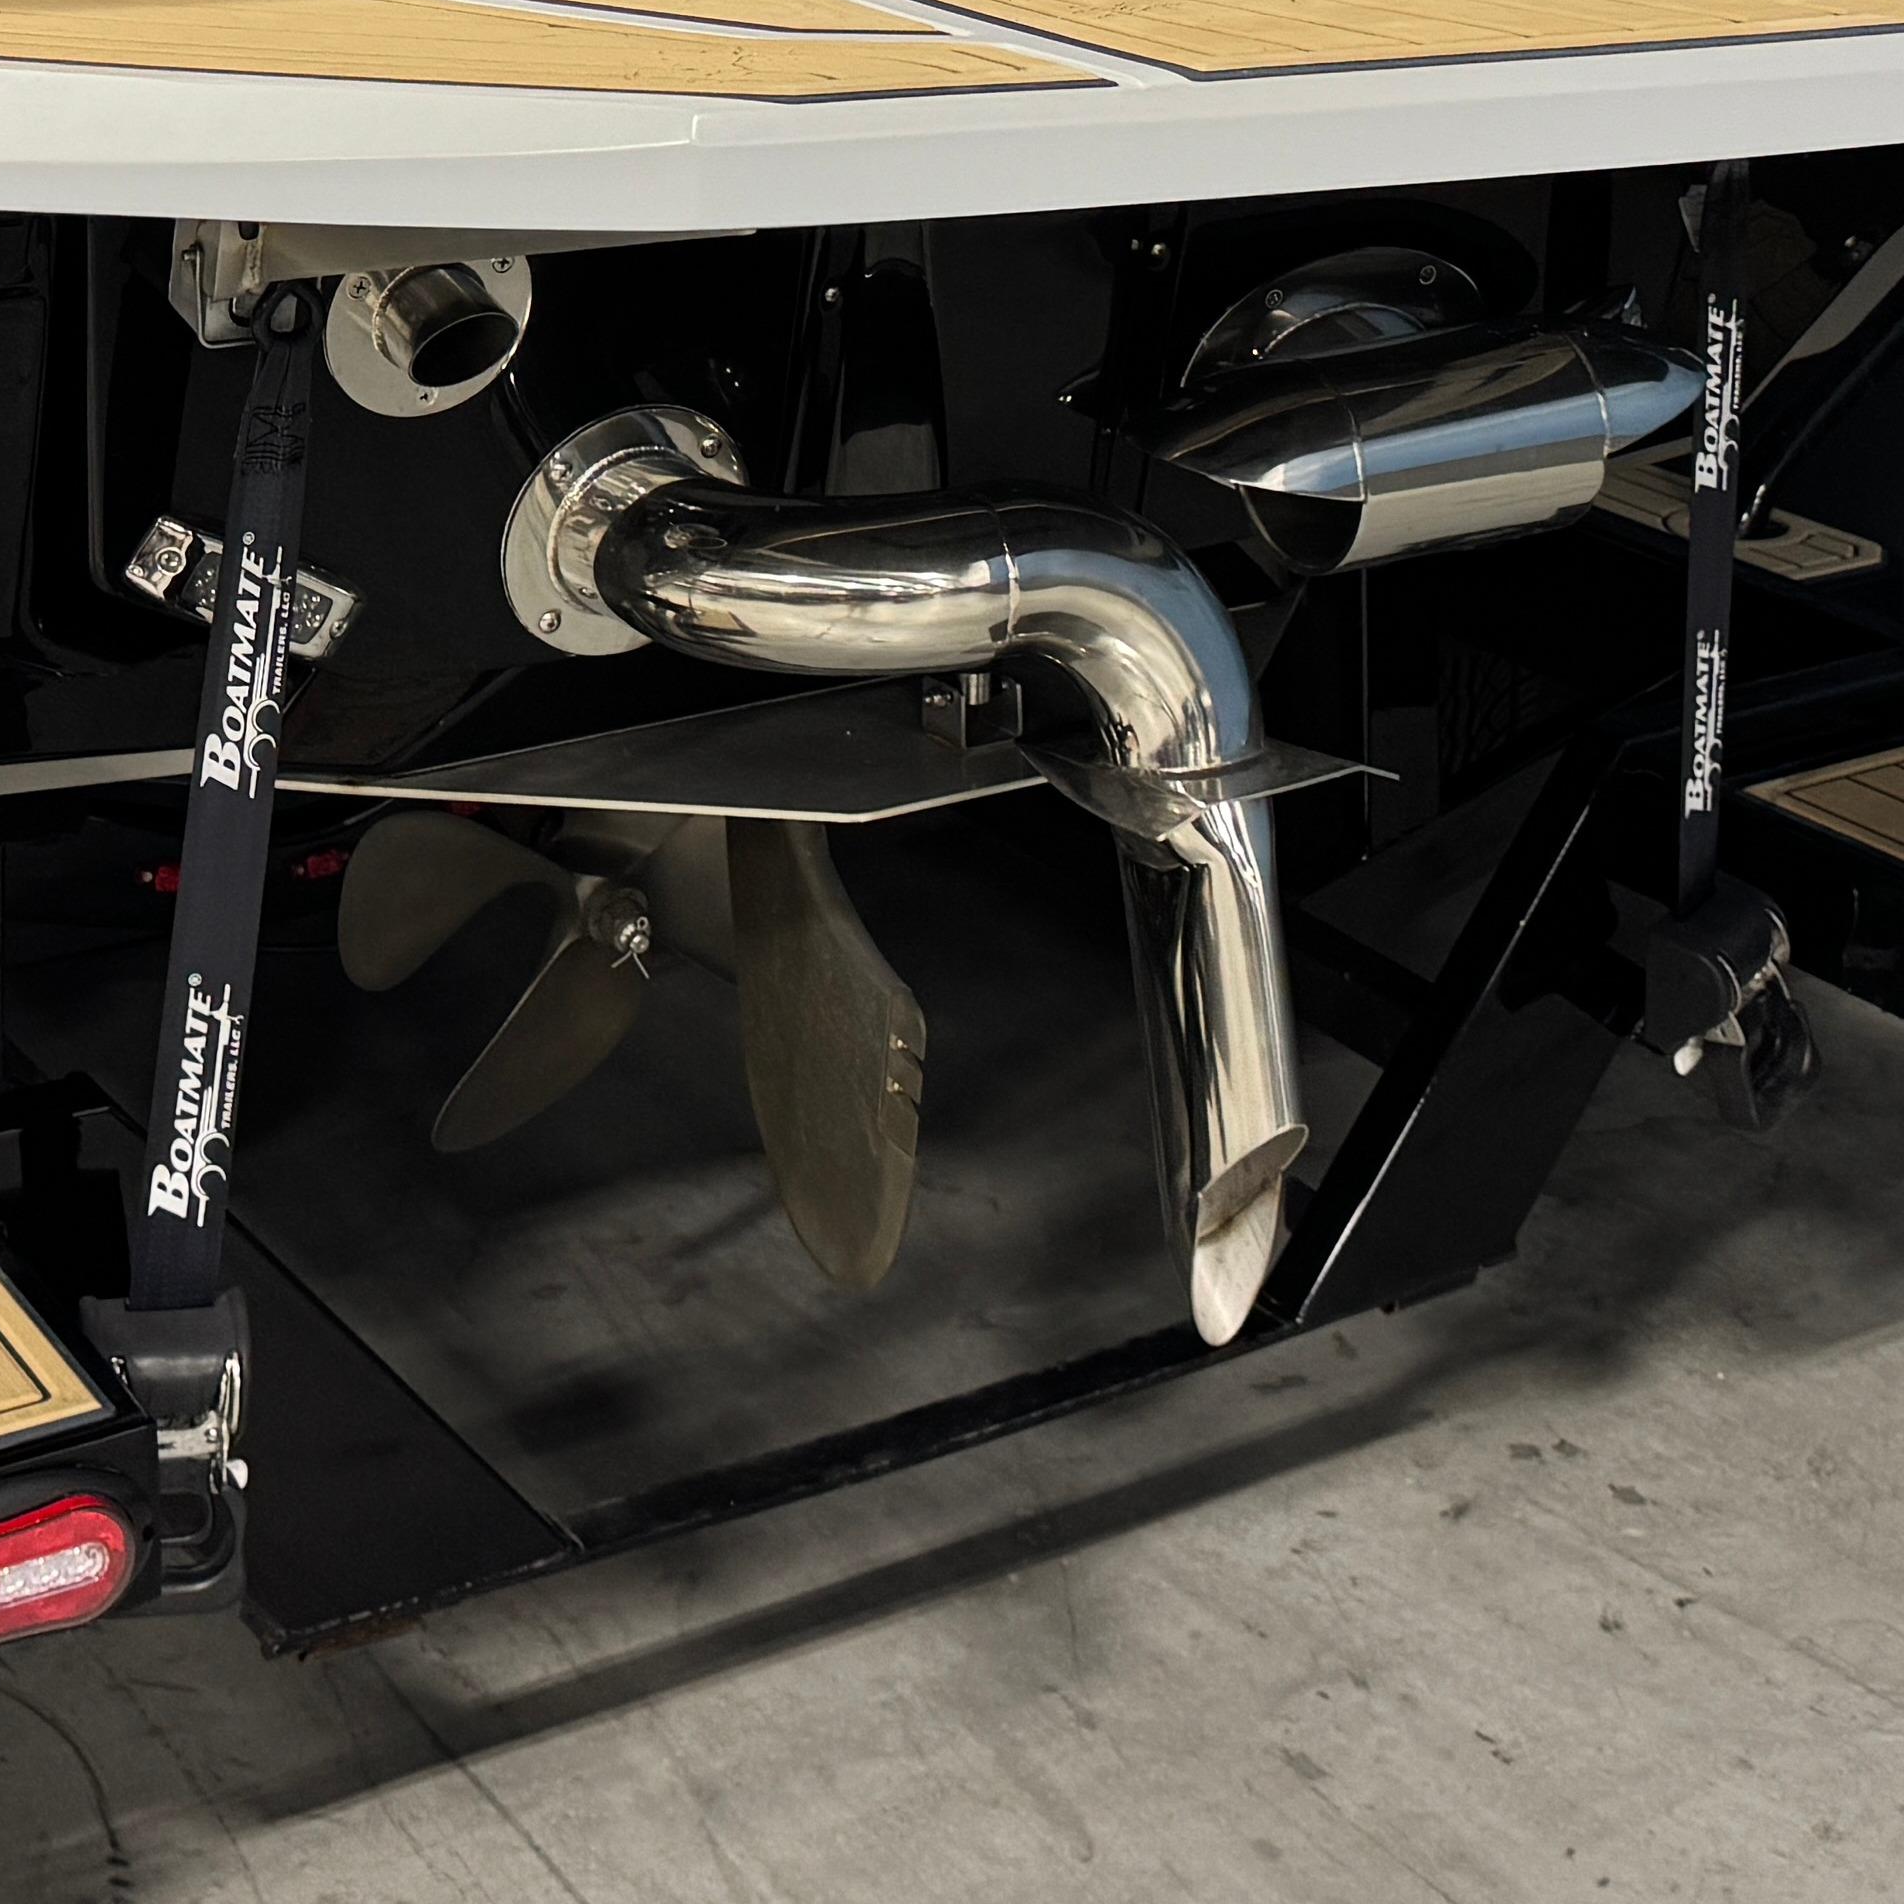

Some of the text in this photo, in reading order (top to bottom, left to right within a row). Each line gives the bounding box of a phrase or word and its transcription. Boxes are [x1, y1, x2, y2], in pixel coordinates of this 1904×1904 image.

[271, 591, 291, 696] TRAILERS, LLC
[220, 1029, 242, 1129] TRAILERS, LLC
